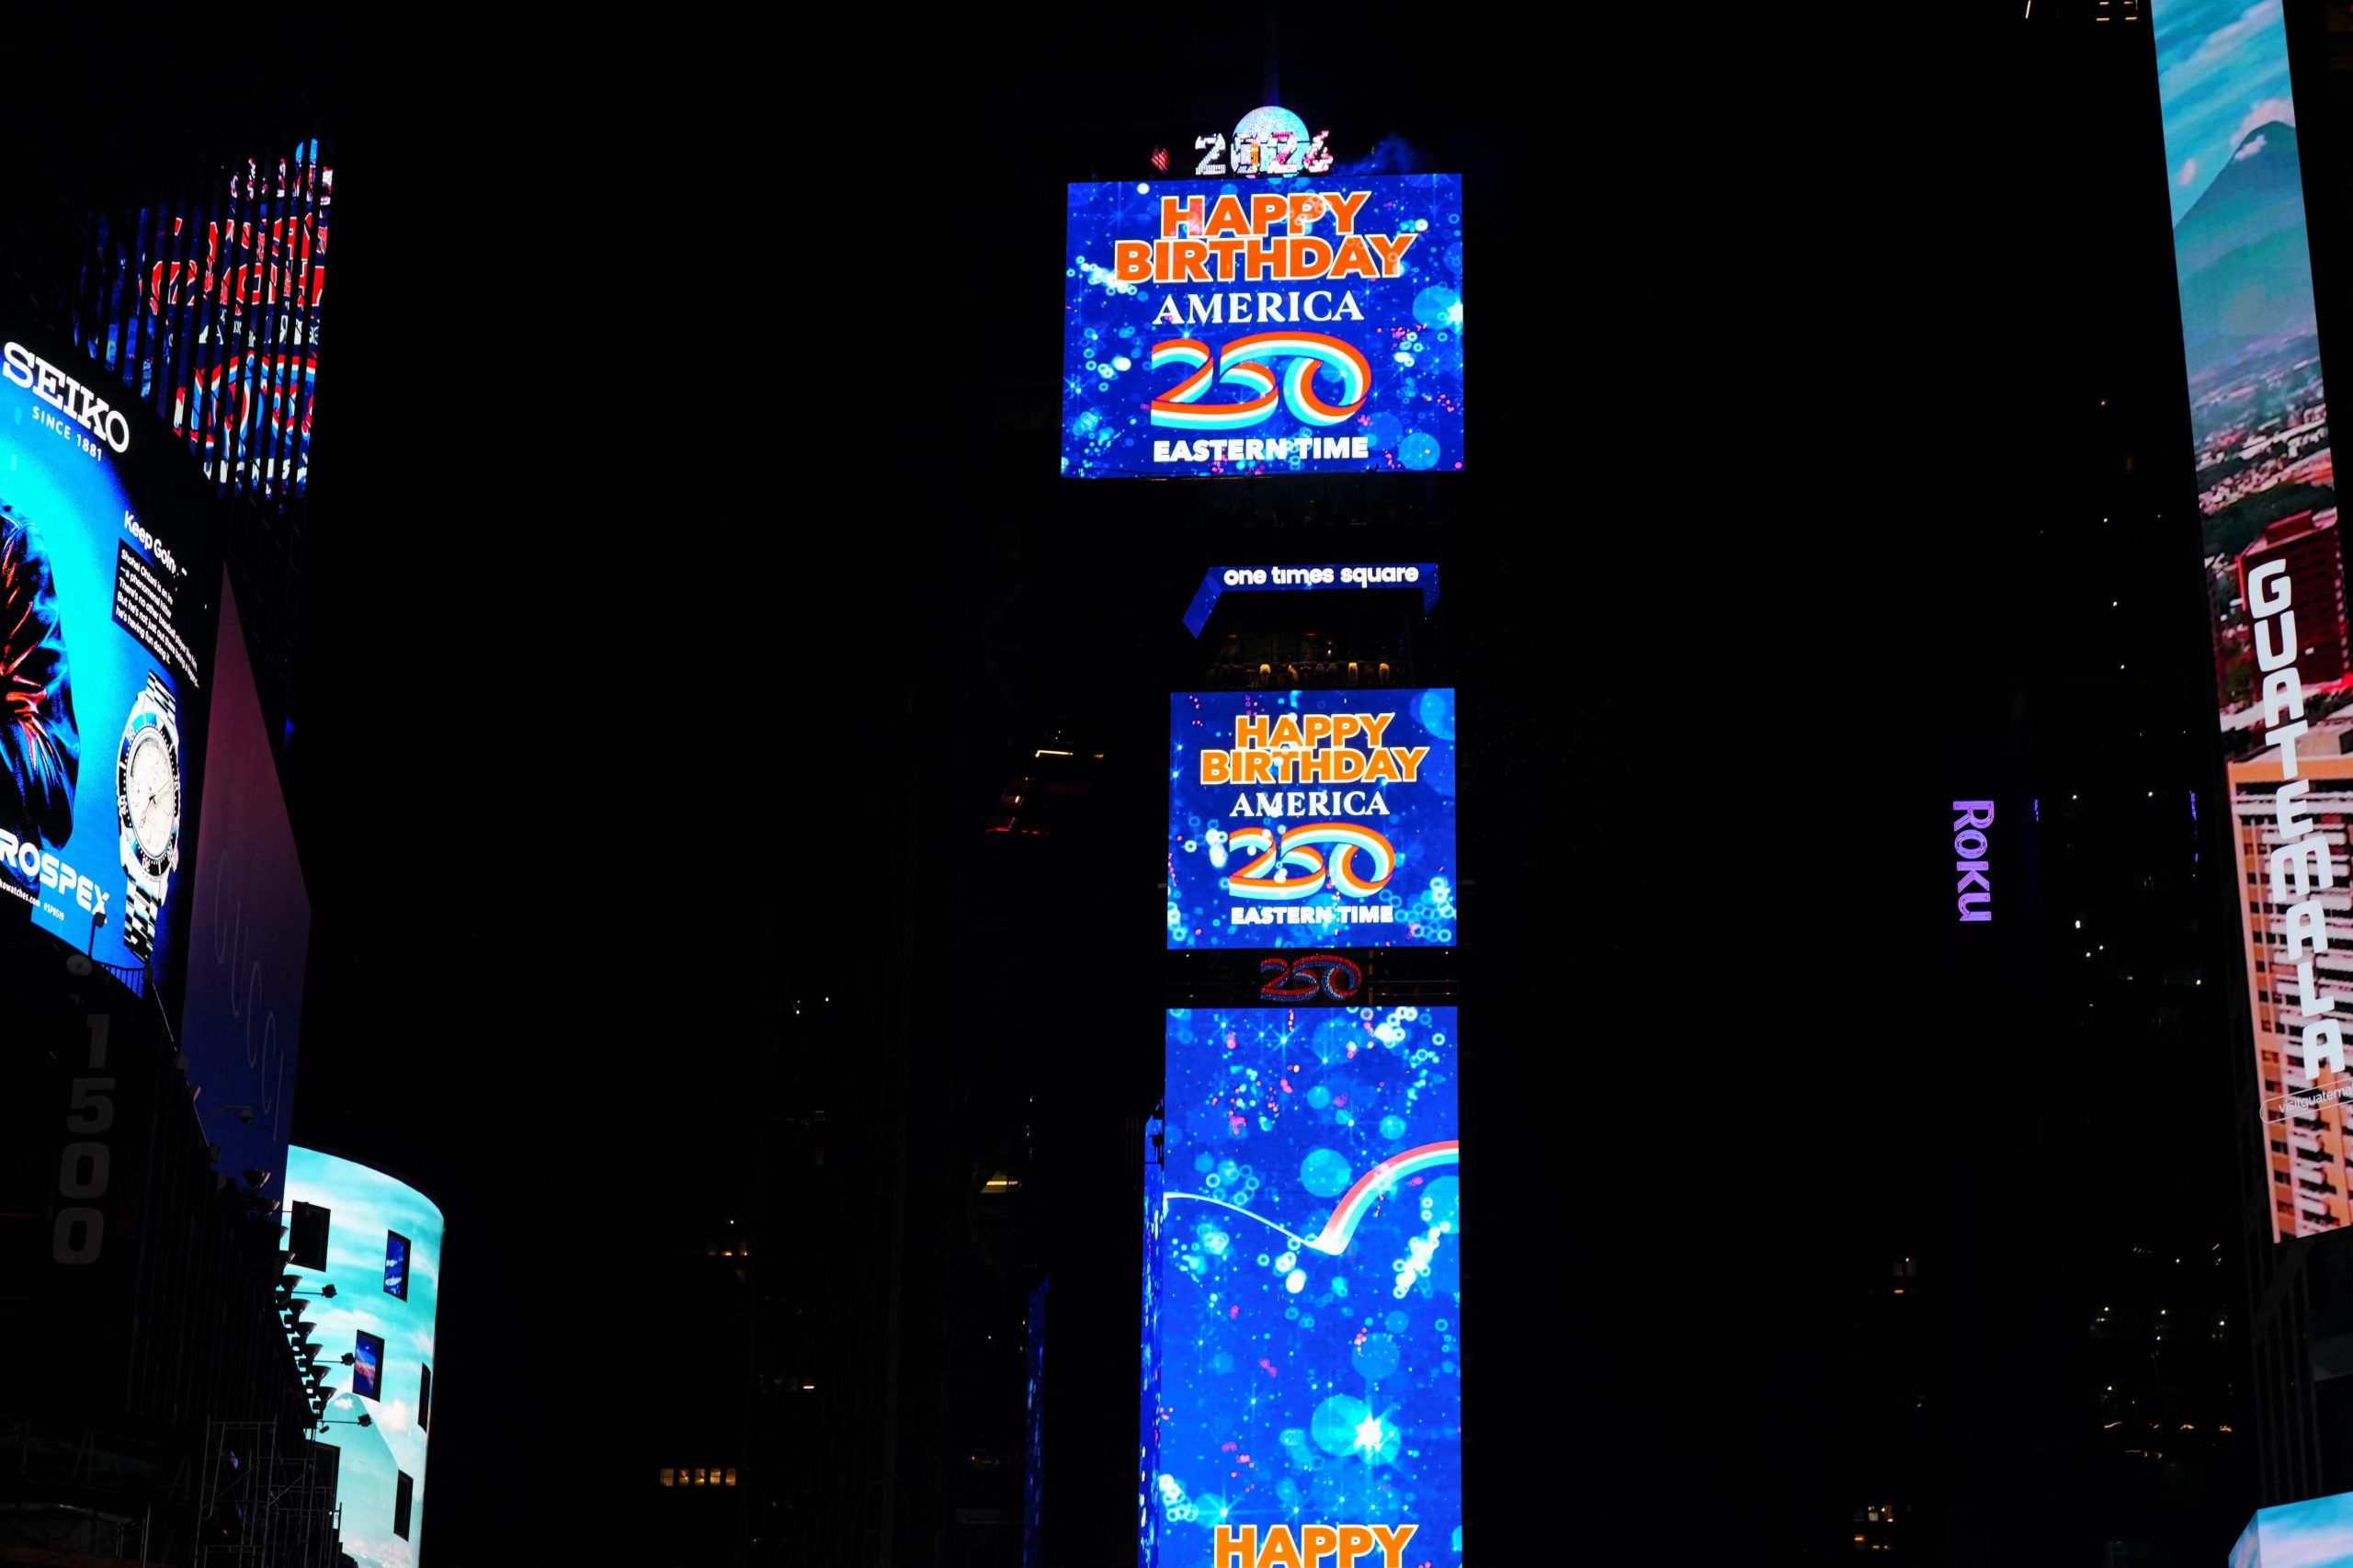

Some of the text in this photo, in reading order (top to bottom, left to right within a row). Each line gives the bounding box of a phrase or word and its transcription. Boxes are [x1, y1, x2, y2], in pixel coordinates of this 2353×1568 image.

[1160, 190, 1372, 237] HAPPY
[1115, 233, 1418, 283] BIRTHDAY
[1153, 290, 1364, 324] AMERICA
[3, 341, 130, 453] SEIKO
[1151, 331, 1371, 430] 250
[32, 405, 102, 461] SINCE 1881
[1154, 437, 1369, 462] EASTERN TIME
[124, 510, 178, 578] Keep Goin
[1223, 564, 1419, 588] one times square
[118, 591, 128, 608] But
[139, 611, 148, 625] not
[139, 596, 146, 608] no
[145, 631, 153, 645] fun
[1235, 712, 1395, 749] HAPPY
[1200, 746, 1430, 785] BIRTHDAY
[1230, 790, 1390, 817] AMERICA
[2248, 558, 2346, 1080] GUATEMALA
[0, 828, 110, 925] ROSPEX
[1229, 823, 1396, 900] 250
[1231, 904, 1393, 926] EASTERN TIME
[1260, 954, 1362, 1002] 250
[52, 1011, 116, 1266] 1500
[1213, 1524, 1418, 1568] HAPPY
